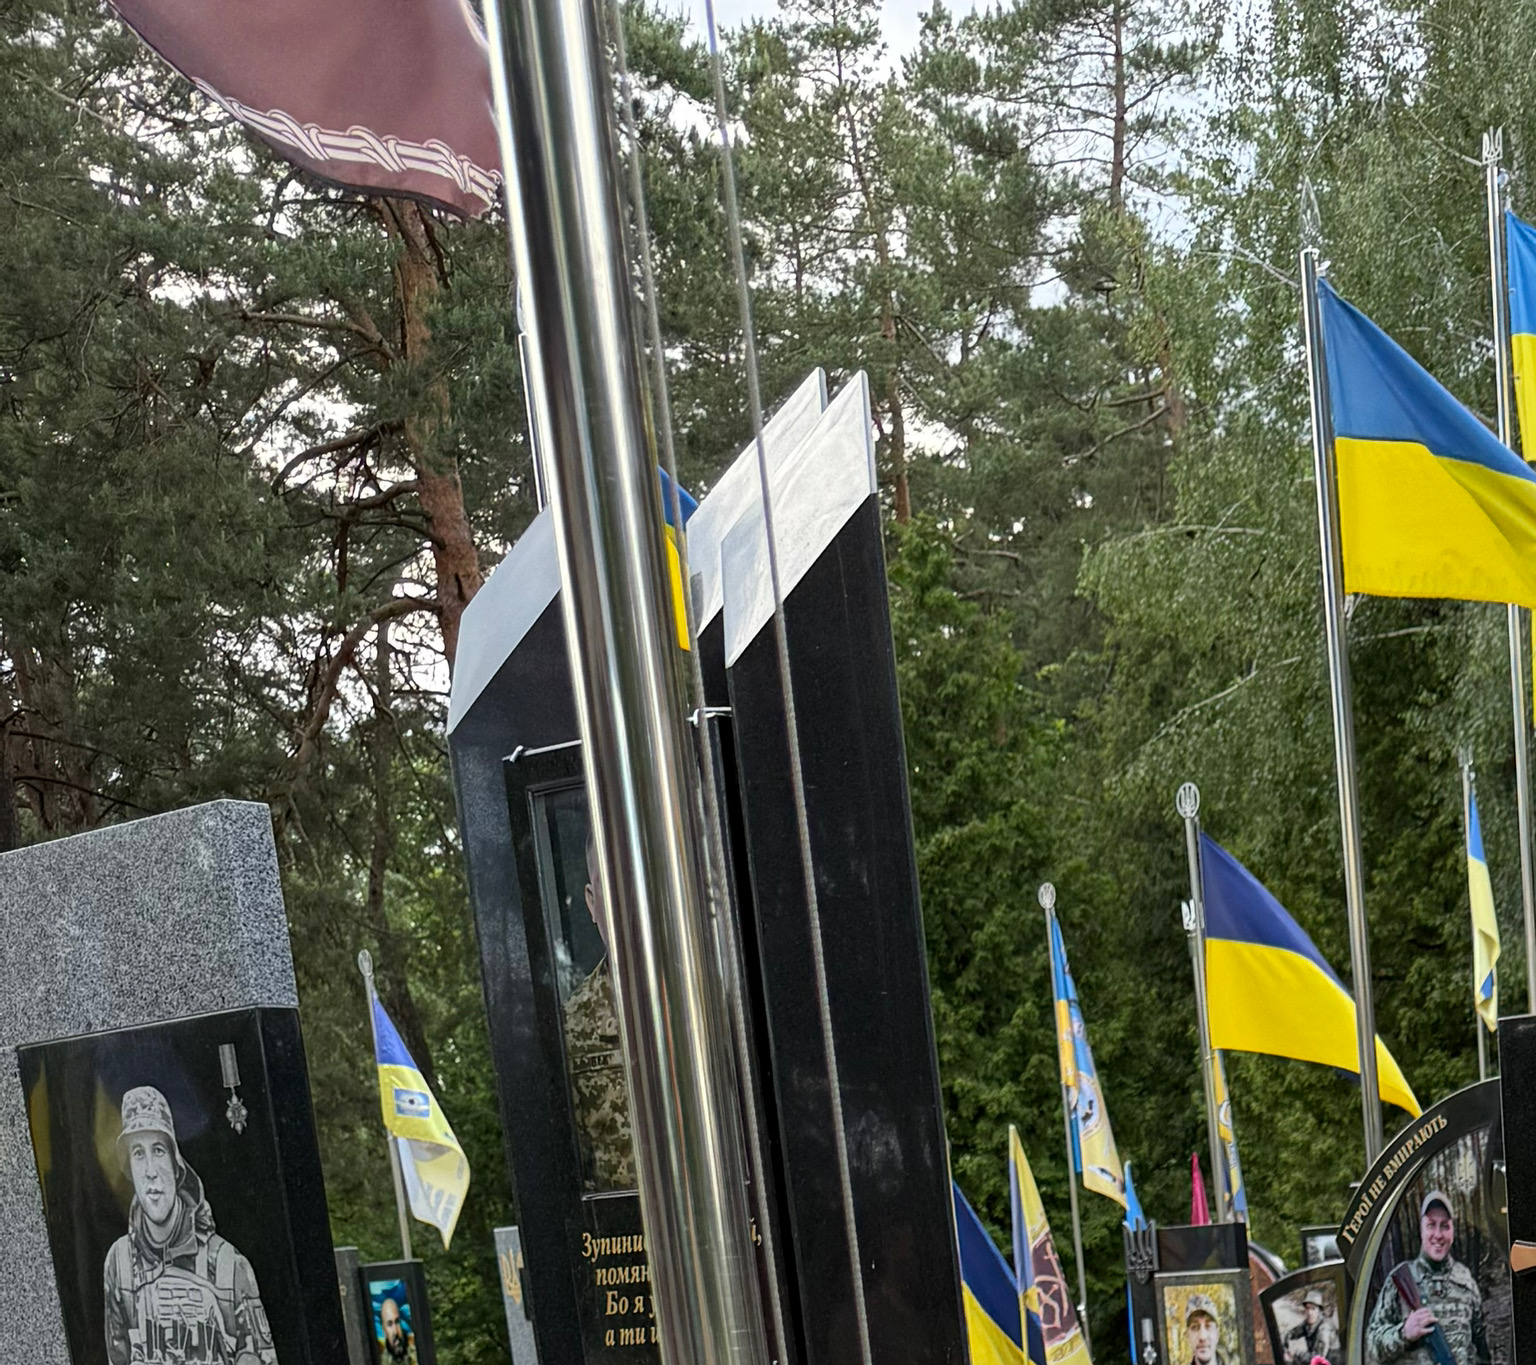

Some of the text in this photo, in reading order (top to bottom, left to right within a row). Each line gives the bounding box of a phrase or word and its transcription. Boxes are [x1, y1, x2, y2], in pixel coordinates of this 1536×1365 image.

[1341, 1114, 1449, 1246] ГЕРОЇ НЕ ВМИРАЮТЬ
[581, 1231, 647, 1264] Зупини
[593, 1264, 652, 1287] помян
[605, 1290, 629, 1316] Бо
[633, 1295, 645, 1314] я
[605, 1329, 616, 1348] а
[619, 1327, 647, 1347] ти
